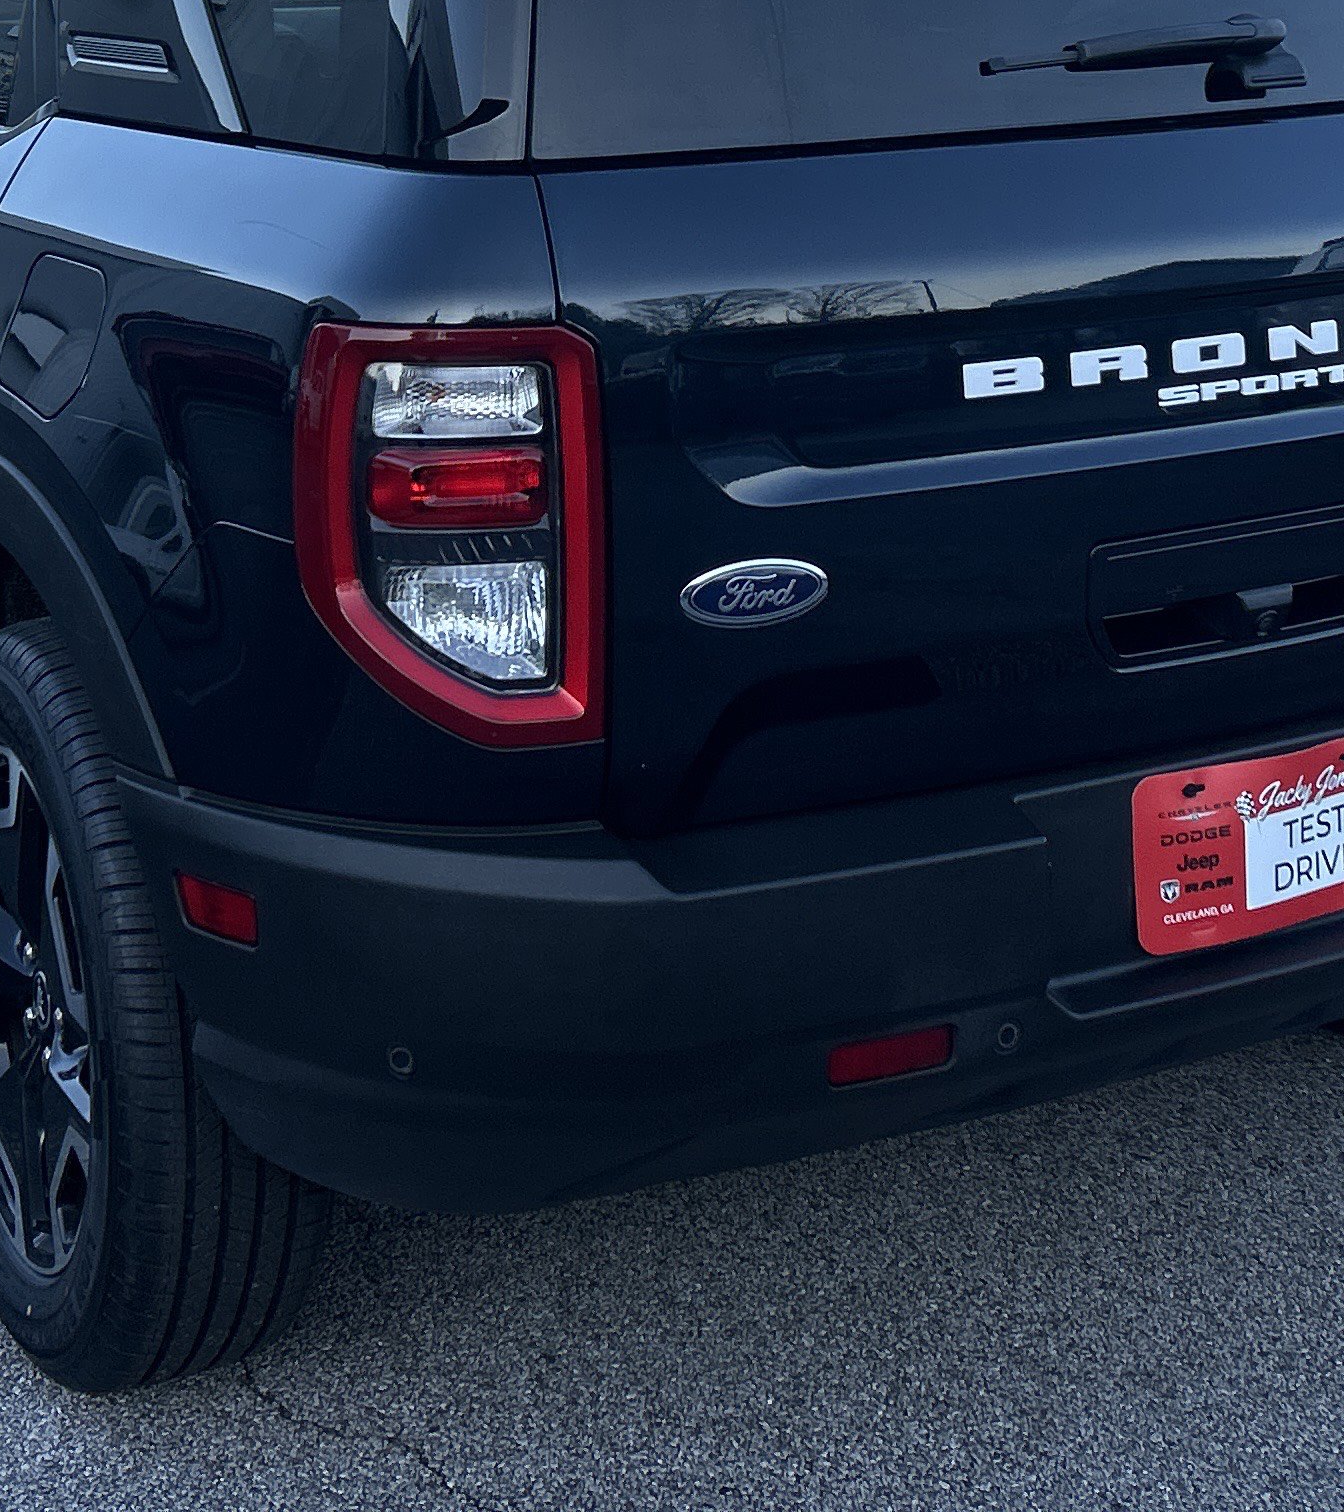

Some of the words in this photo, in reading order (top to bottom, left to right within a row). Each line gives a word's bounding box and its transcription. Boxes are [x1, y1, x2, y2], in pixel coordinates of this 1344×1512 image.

[718, 573, 796, 613] Ford
[1257, 774, 1312, 822] Jacky
[1160, 825, 1231, 847] DODGE
[1176, 853, 1220, 873] Jeep
[1184, 876, 1234, 893] RAM
[1220, 903, 1235, 915] GA
